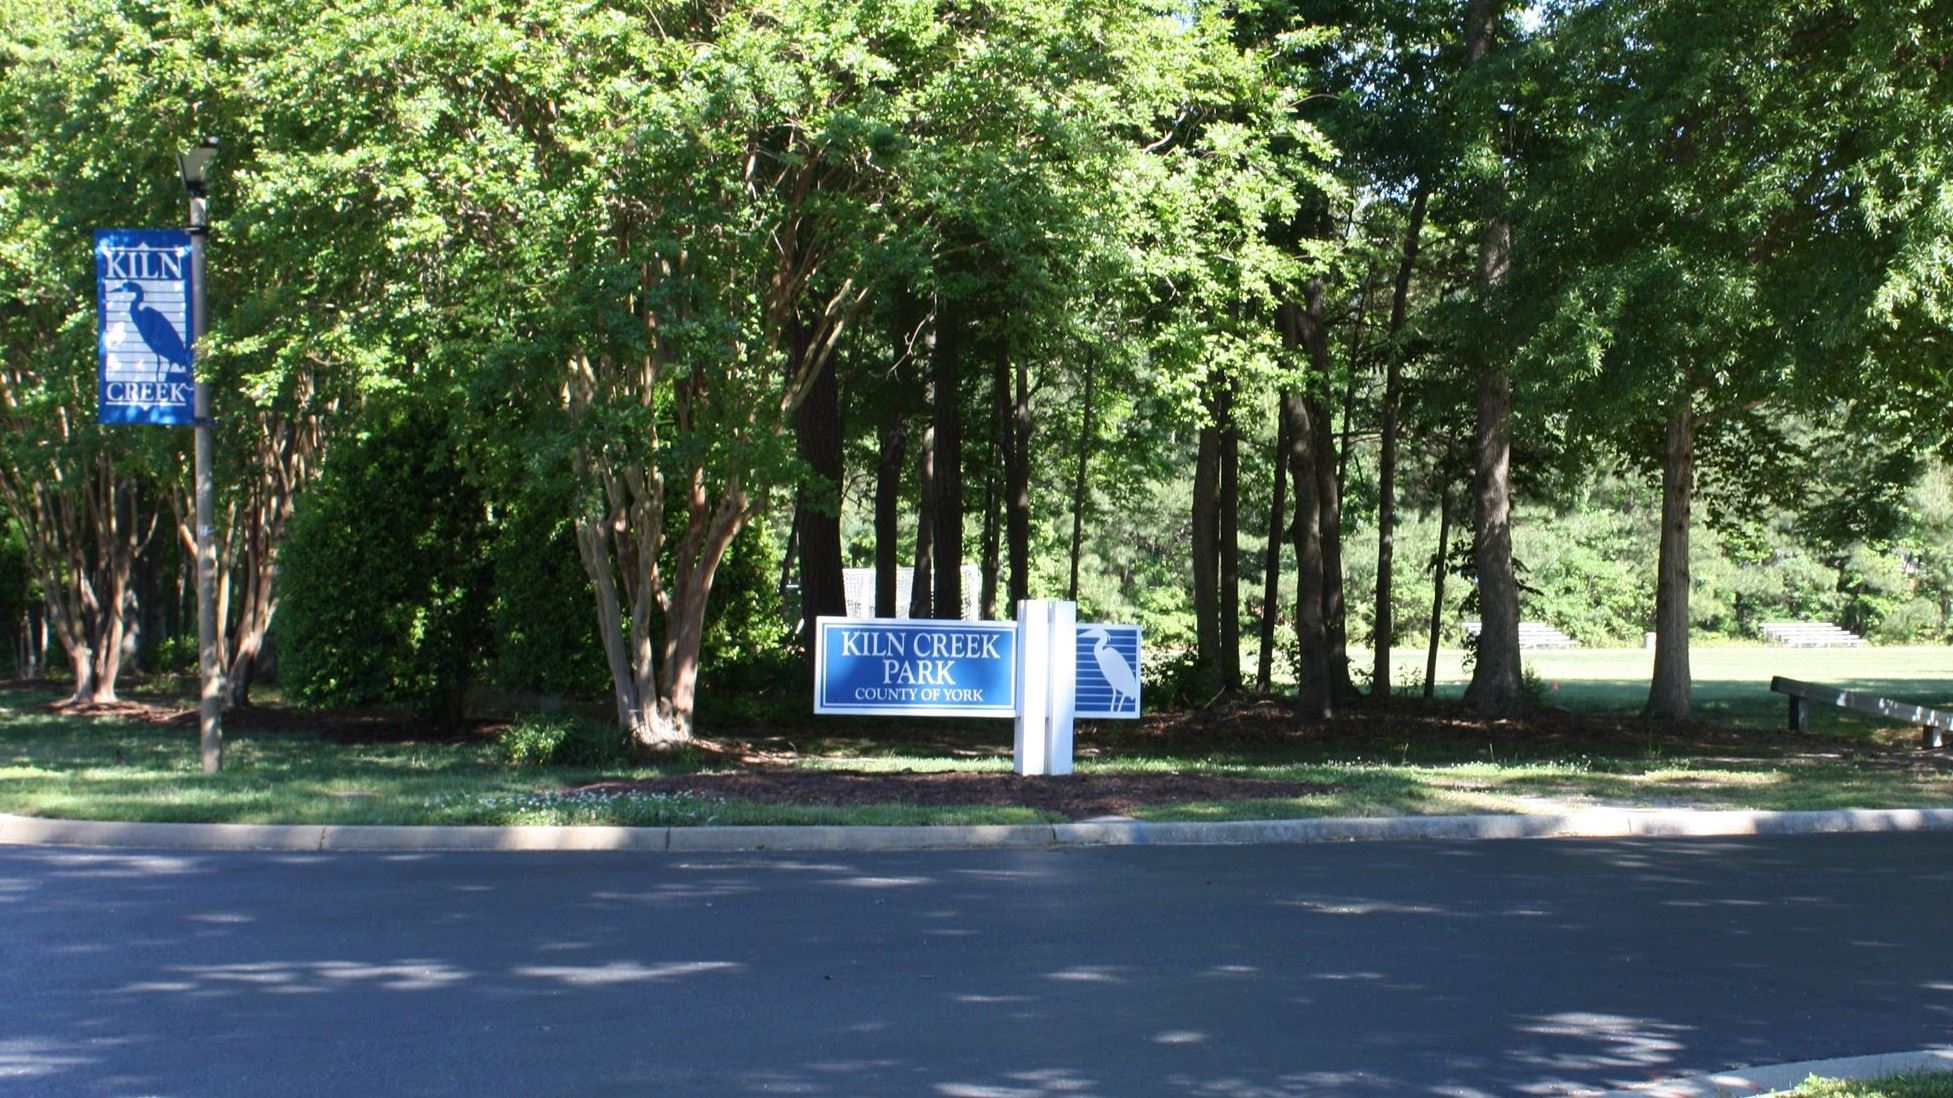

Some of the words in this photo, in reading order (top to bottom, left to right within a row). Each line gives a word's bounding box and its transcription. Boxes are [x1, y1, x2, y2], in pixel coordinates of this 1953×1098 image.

[106, 252, 183, 279] KILN
[106, 382, 187, 402] CREEK
[841, 631, 905, 656] KILN
[913, 632, 1000, 659] CREEK
[883, 659, 956, 685] PARK
[855, 687, 917, 701] COUNTY
[921, 688, 941, 702] OF
[943, 689, 983, 702] YORK
